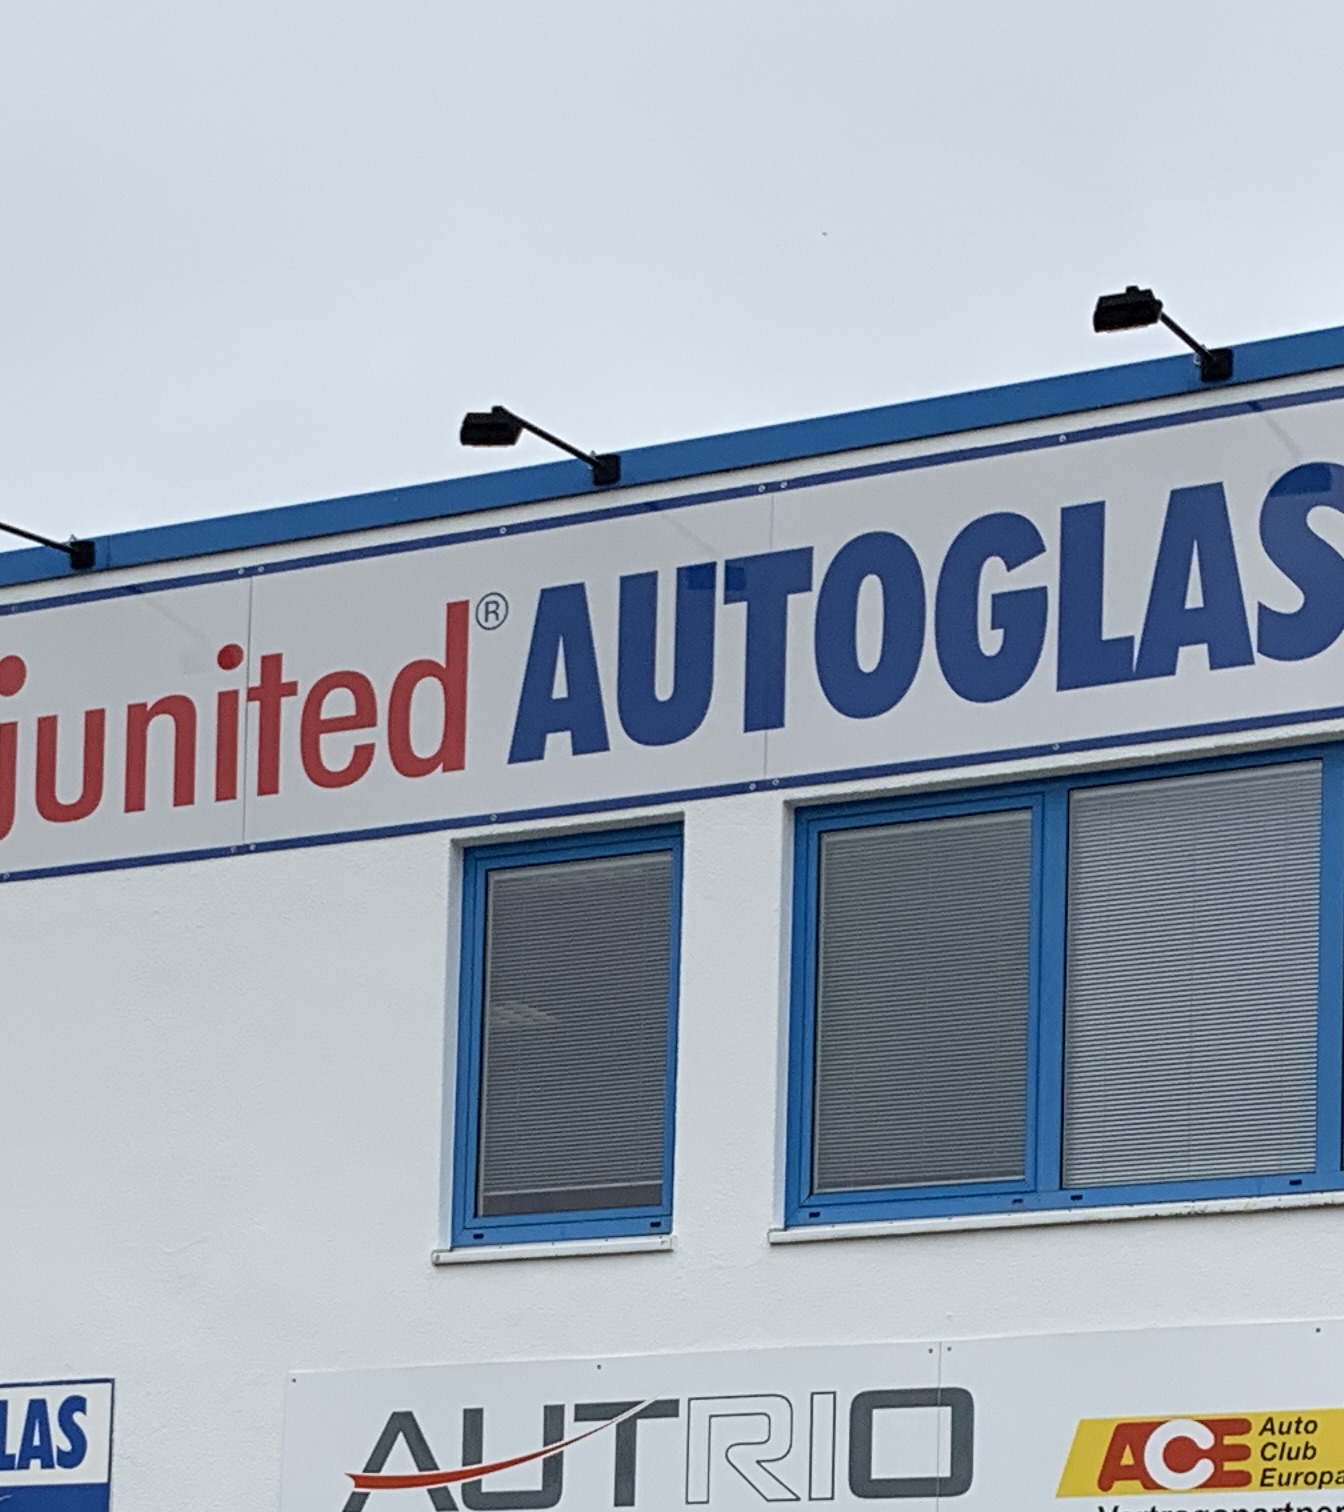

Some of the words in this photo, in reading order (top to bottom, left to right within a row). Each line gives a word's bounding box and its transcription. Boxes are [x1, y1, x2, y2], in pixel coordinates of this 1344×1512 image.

[1259, 1416, 1318, 1436] Auto
[1097, 1418, 1253, 1493] ACE
[1260, 1442, 1317, 1461] Club
